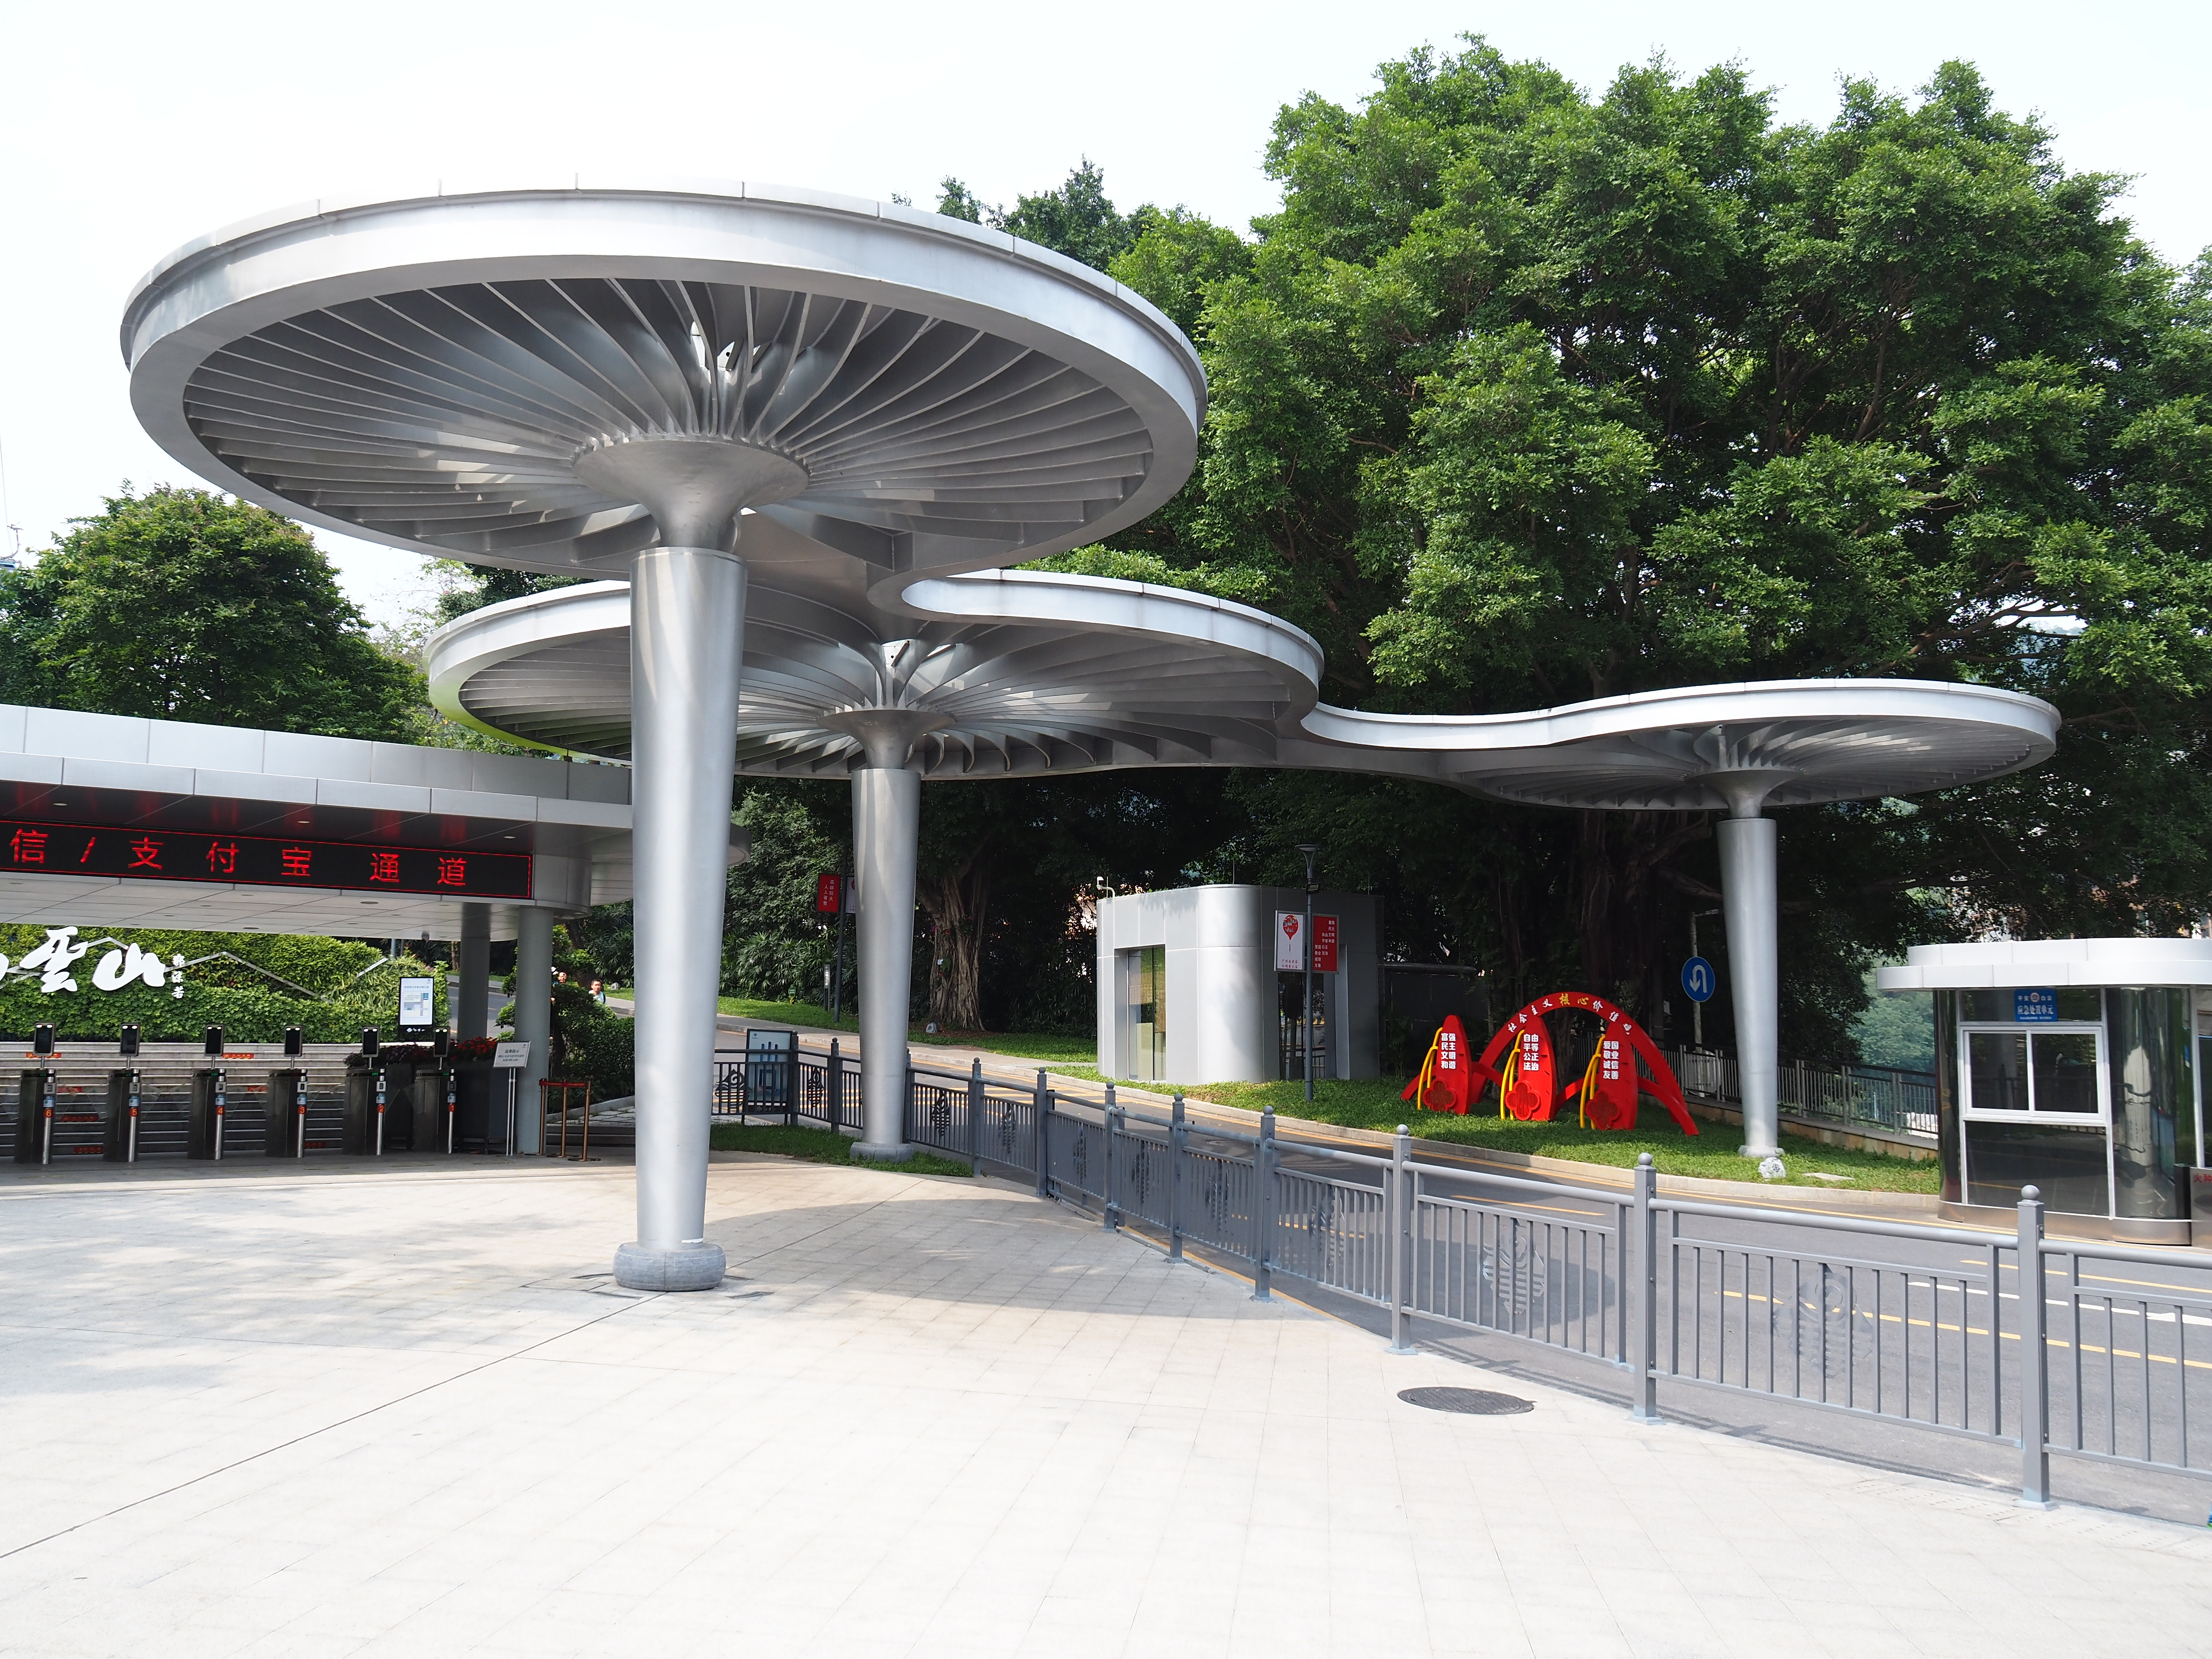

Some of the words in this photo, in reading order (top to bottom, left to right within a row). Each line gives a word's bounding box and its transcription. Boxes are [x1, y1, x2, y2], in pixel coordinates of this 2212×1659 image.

[1508, 993, 1632, 1035] 社会主义核心价值观
[1441, 1033, 1456, 1042] 富强
[1523, 1033, 1539, 1042] 自由
[1441, 1042, 1456, 1051] 民主
[1523, 1043, 1539, 1052] 平等
[1603, 1041, 1619, 1050] 爱国
[1441, 1051, 1456, 1059] 文明
[1523, 1052, 1539, 1061] 公正
[1603, 1050, 1619, 1059] 敬业
[1441, 1060, 1456, 1069] 和谐
[1523, 1062, 1539, 1071] 法治
[1603, 1060, 1619, 1069] 诚信
[1603, 1070, 1619, 1080] 友善
